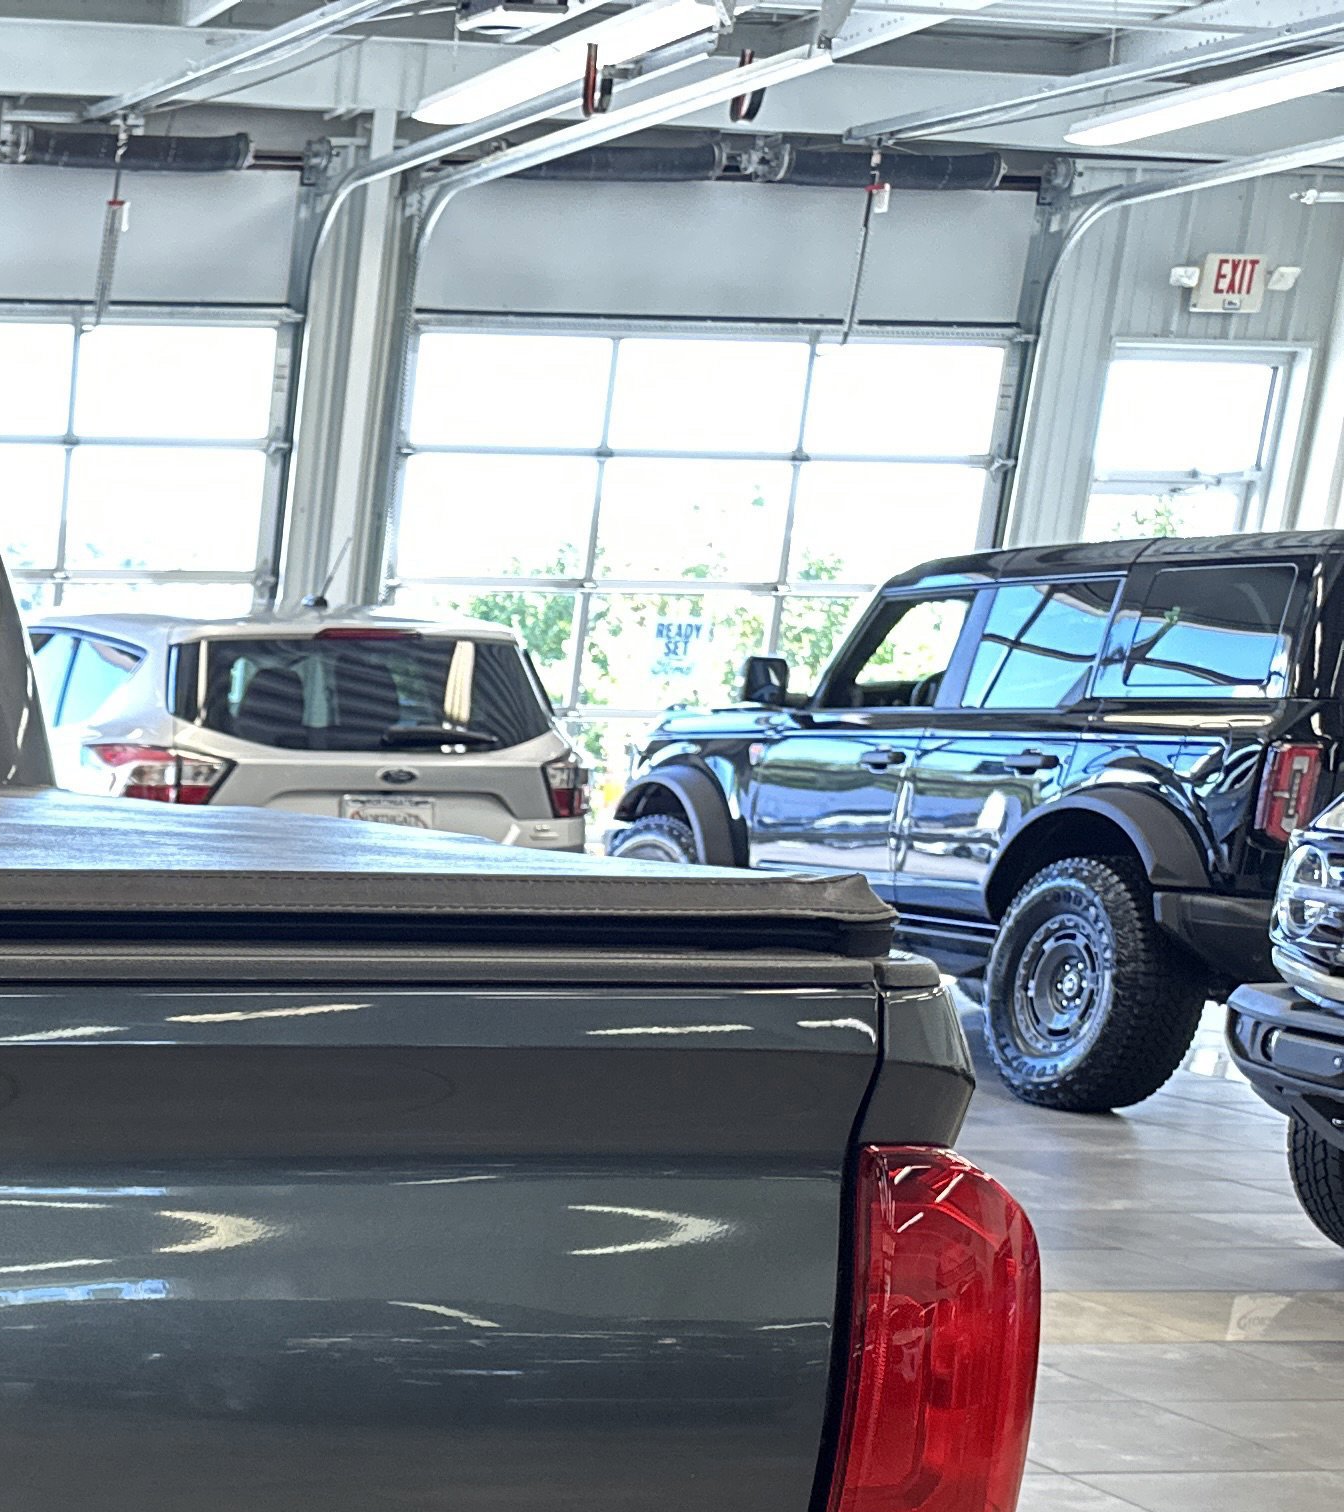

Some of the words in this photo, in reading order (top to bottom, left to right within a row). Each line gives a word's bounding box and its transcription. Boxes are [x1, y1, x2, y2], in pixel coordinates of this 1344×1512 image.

[1213, 259, 1261, 295] EXIT
[656, 623, 703, 639] READY
[664, 640, 690, 657] SET
